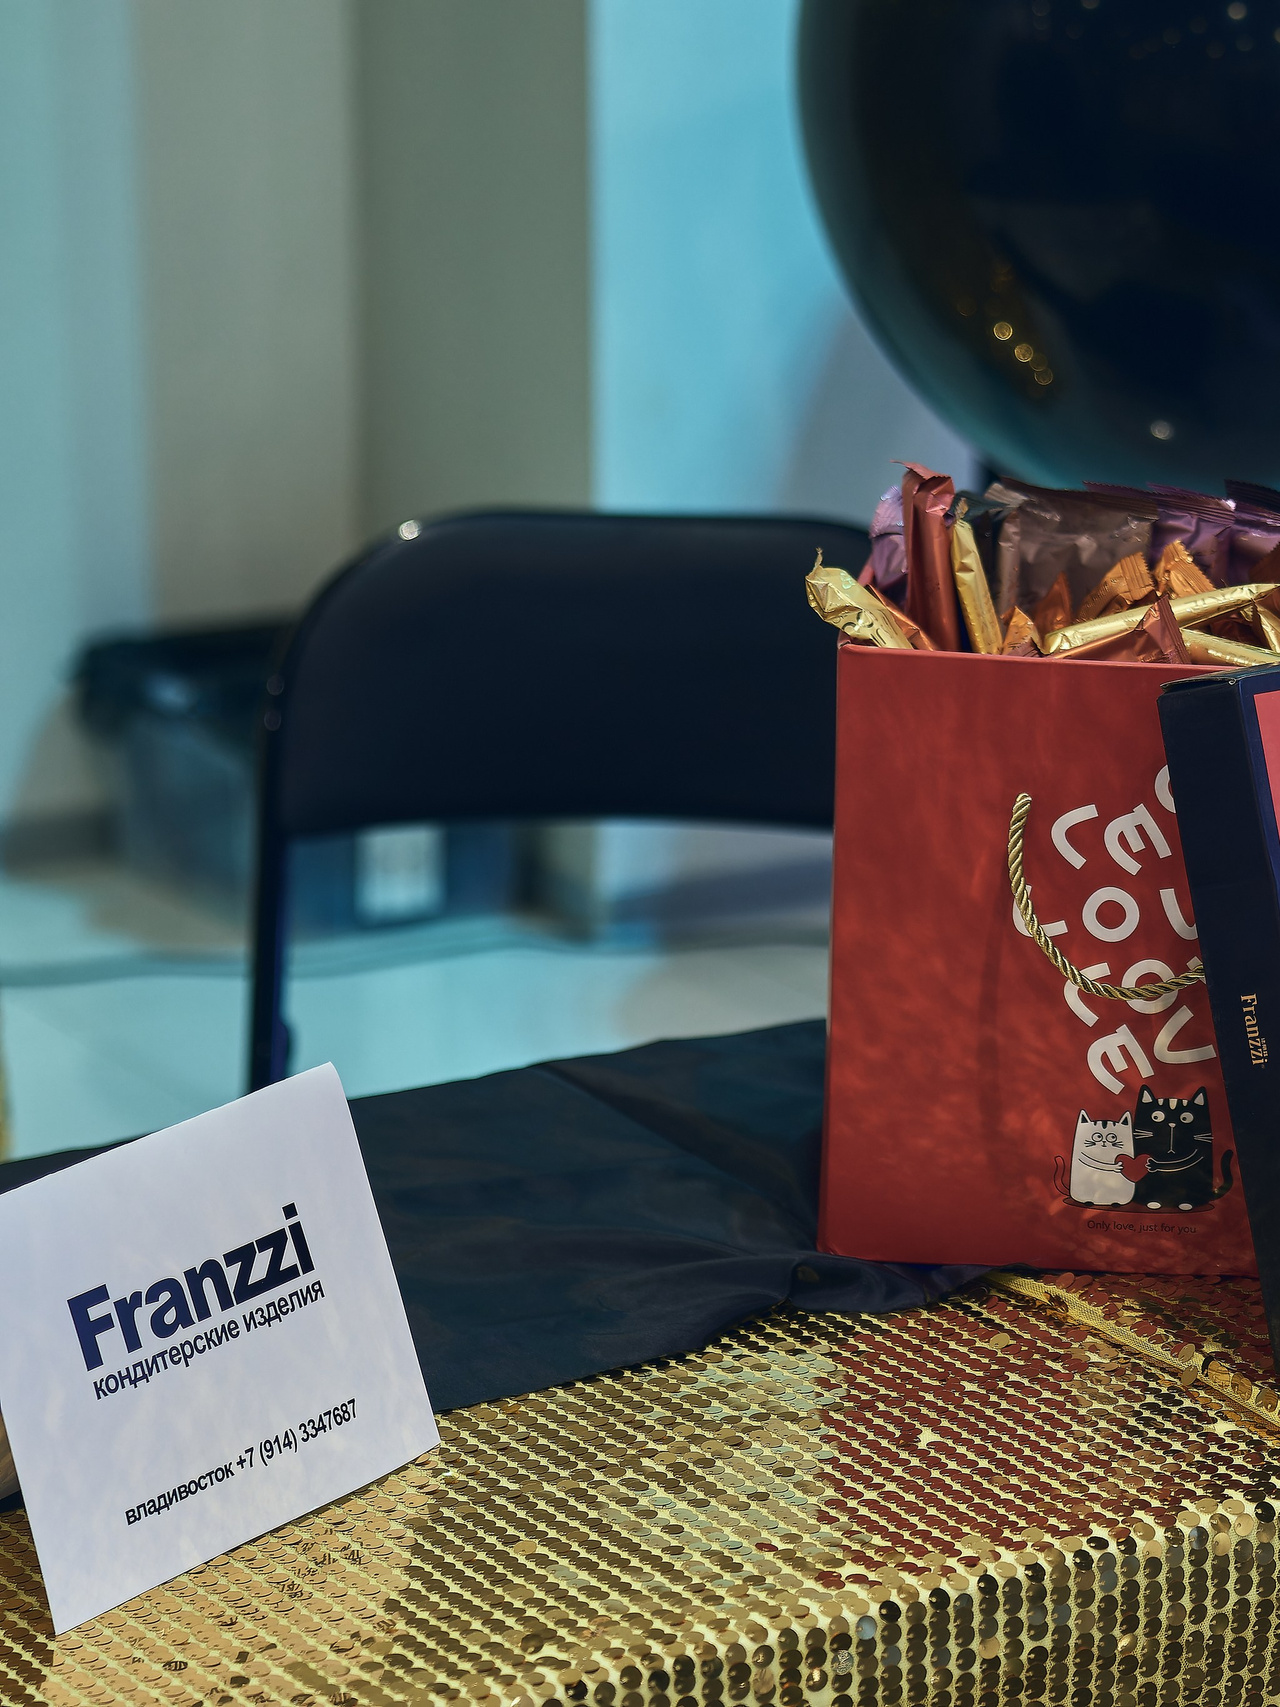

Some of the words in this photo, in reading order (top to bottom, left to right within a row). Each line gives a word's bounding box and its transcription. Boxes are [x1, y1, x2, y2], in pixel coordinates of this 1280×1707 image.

[1240, 993, 1268, 1066] Franzzi
[67, 1202, 316, 1371] Franzzi
[1087, 1220, 1110, 1231] Only
[1113, 1221, 1136, 1232] love,
[1138, 1223, 1158, 1233] just
[1161, 1223, 1175, 1232] for
[1177, 1226, 1197, 1235] you
[93, 1319, 240, 1400] кондитерские
[242, 1280, 325, 1332] изделия
[125, 1461, 235, 1526] владивосток
[236, 1447, 254, 1470] +7
[259, 1428, 298, 1466] (914)
[298, 1398, 357, 1442] 3347687
